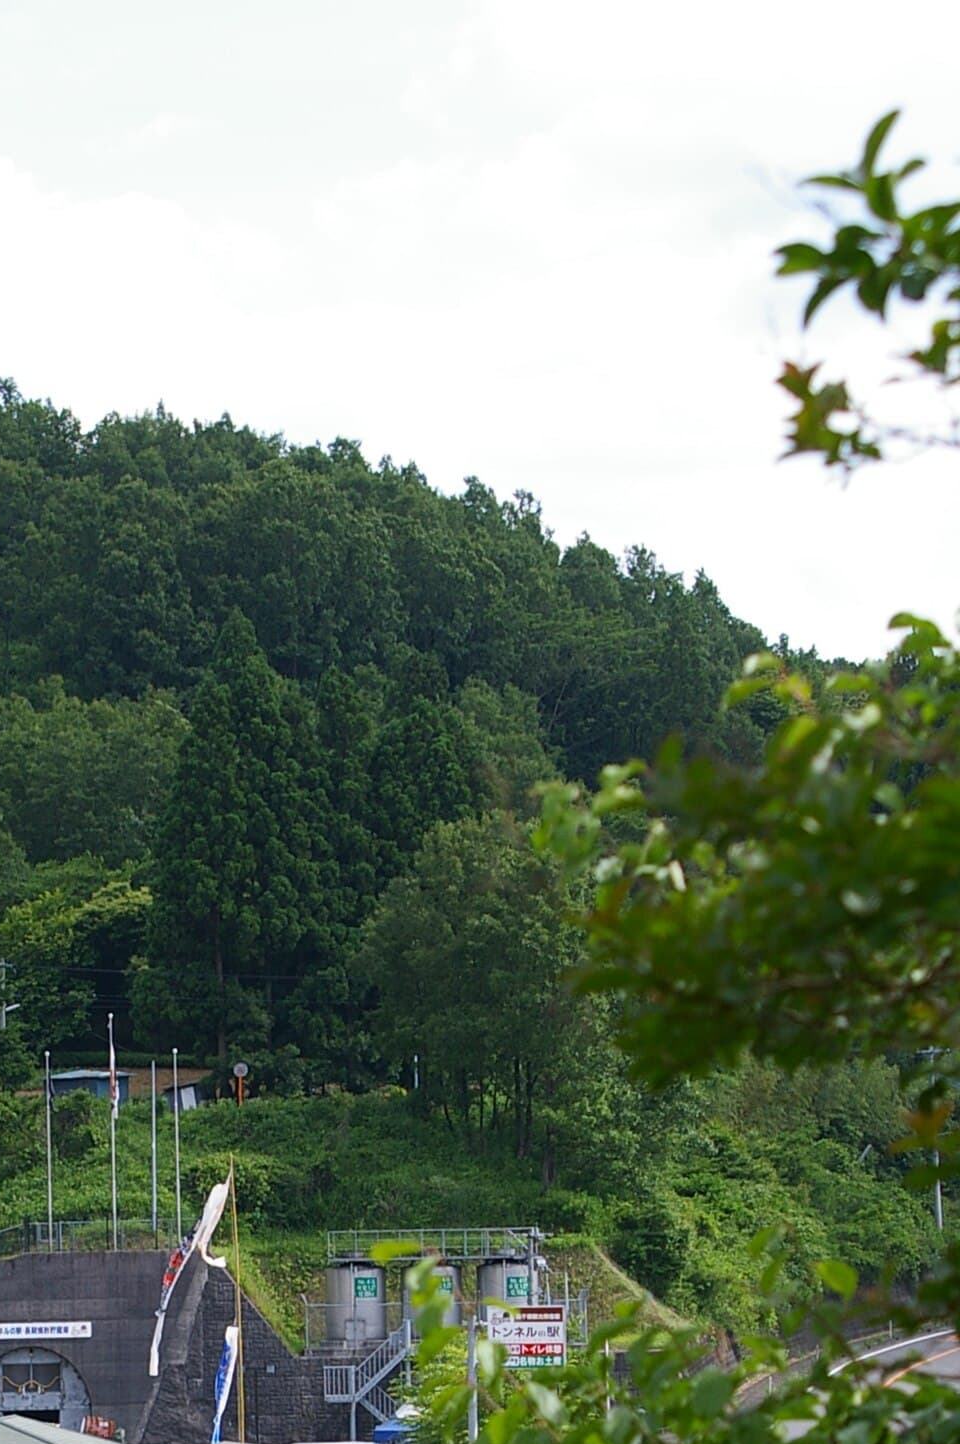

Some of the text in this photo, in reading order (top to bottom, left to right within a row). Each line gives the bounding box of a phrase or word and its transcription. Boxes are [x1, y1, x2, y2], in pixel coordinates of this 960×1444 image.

[492, 1326, 560, 1338] トンネルの駅
